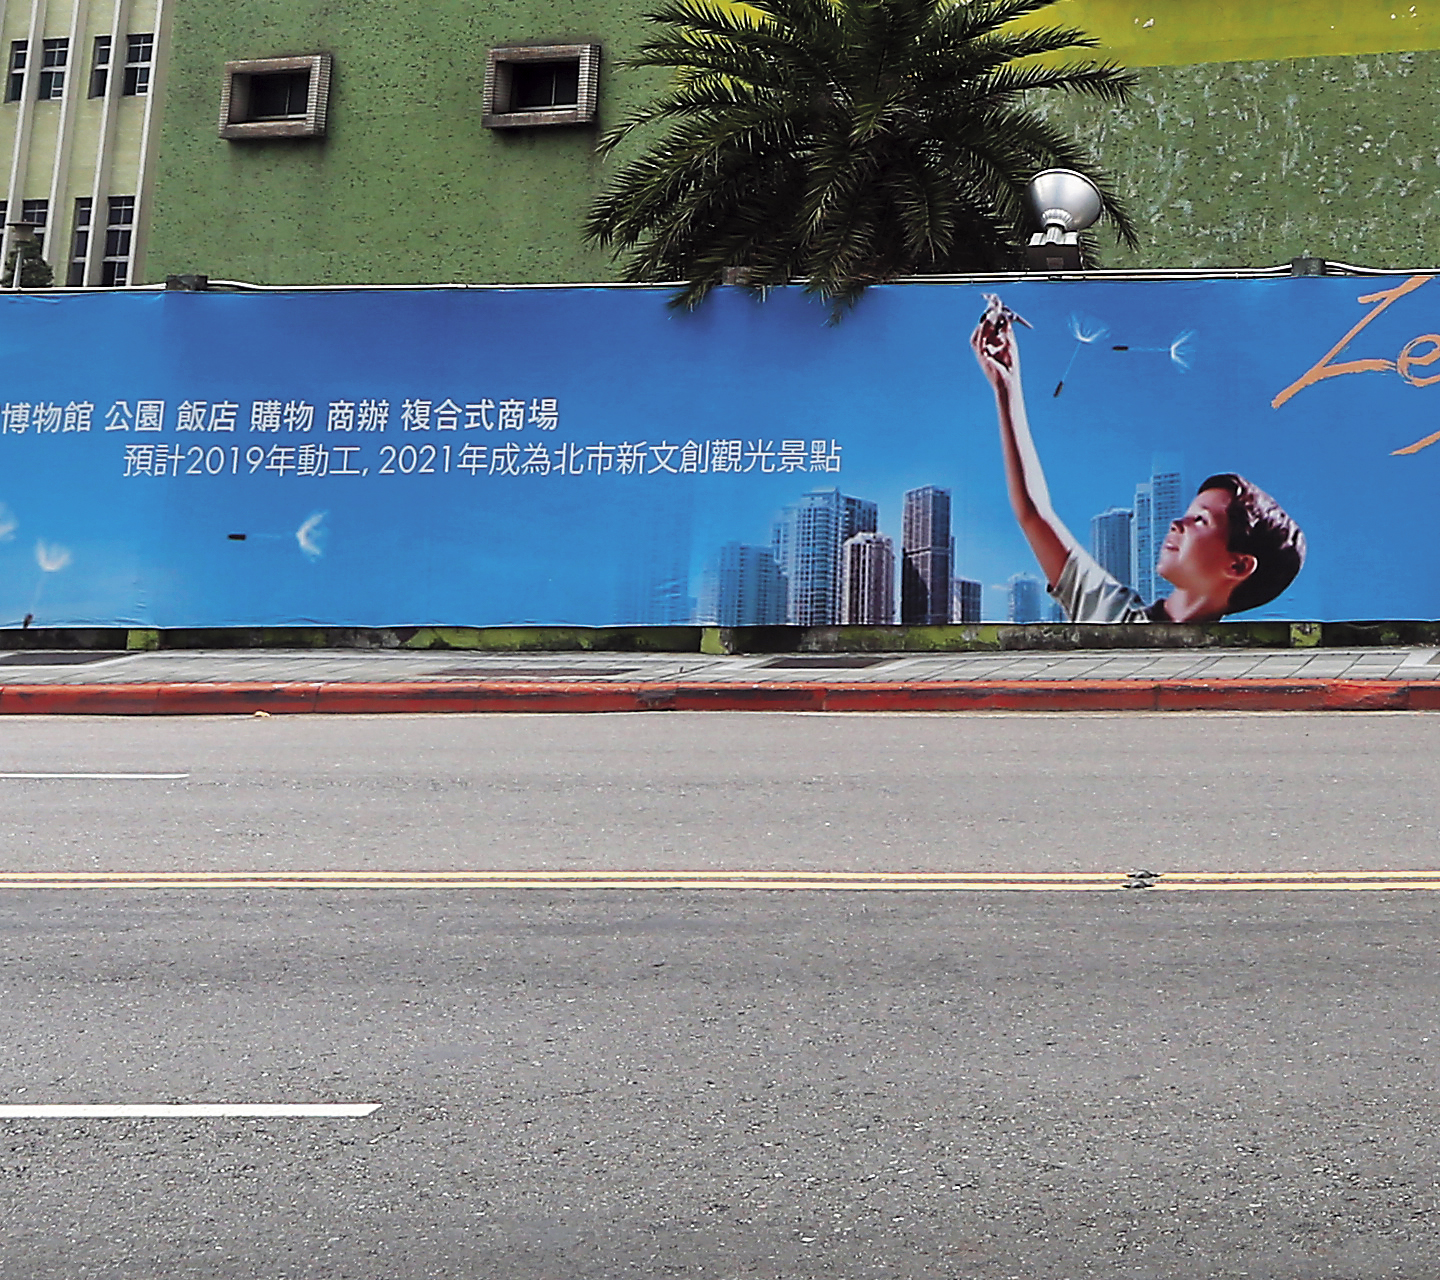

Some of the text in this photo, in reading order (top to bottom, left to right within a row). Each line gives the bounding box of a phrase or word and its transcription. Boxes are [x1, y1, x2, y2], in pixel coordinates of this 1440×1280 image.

[104, 399, 165, 433] 公園
[175, 399, 240, 433] 飯店
[250, 399, 314, 433] 購物
[327, 399, 390, 433] 商辦
[400, 397, 560, 432] 複合式商場
